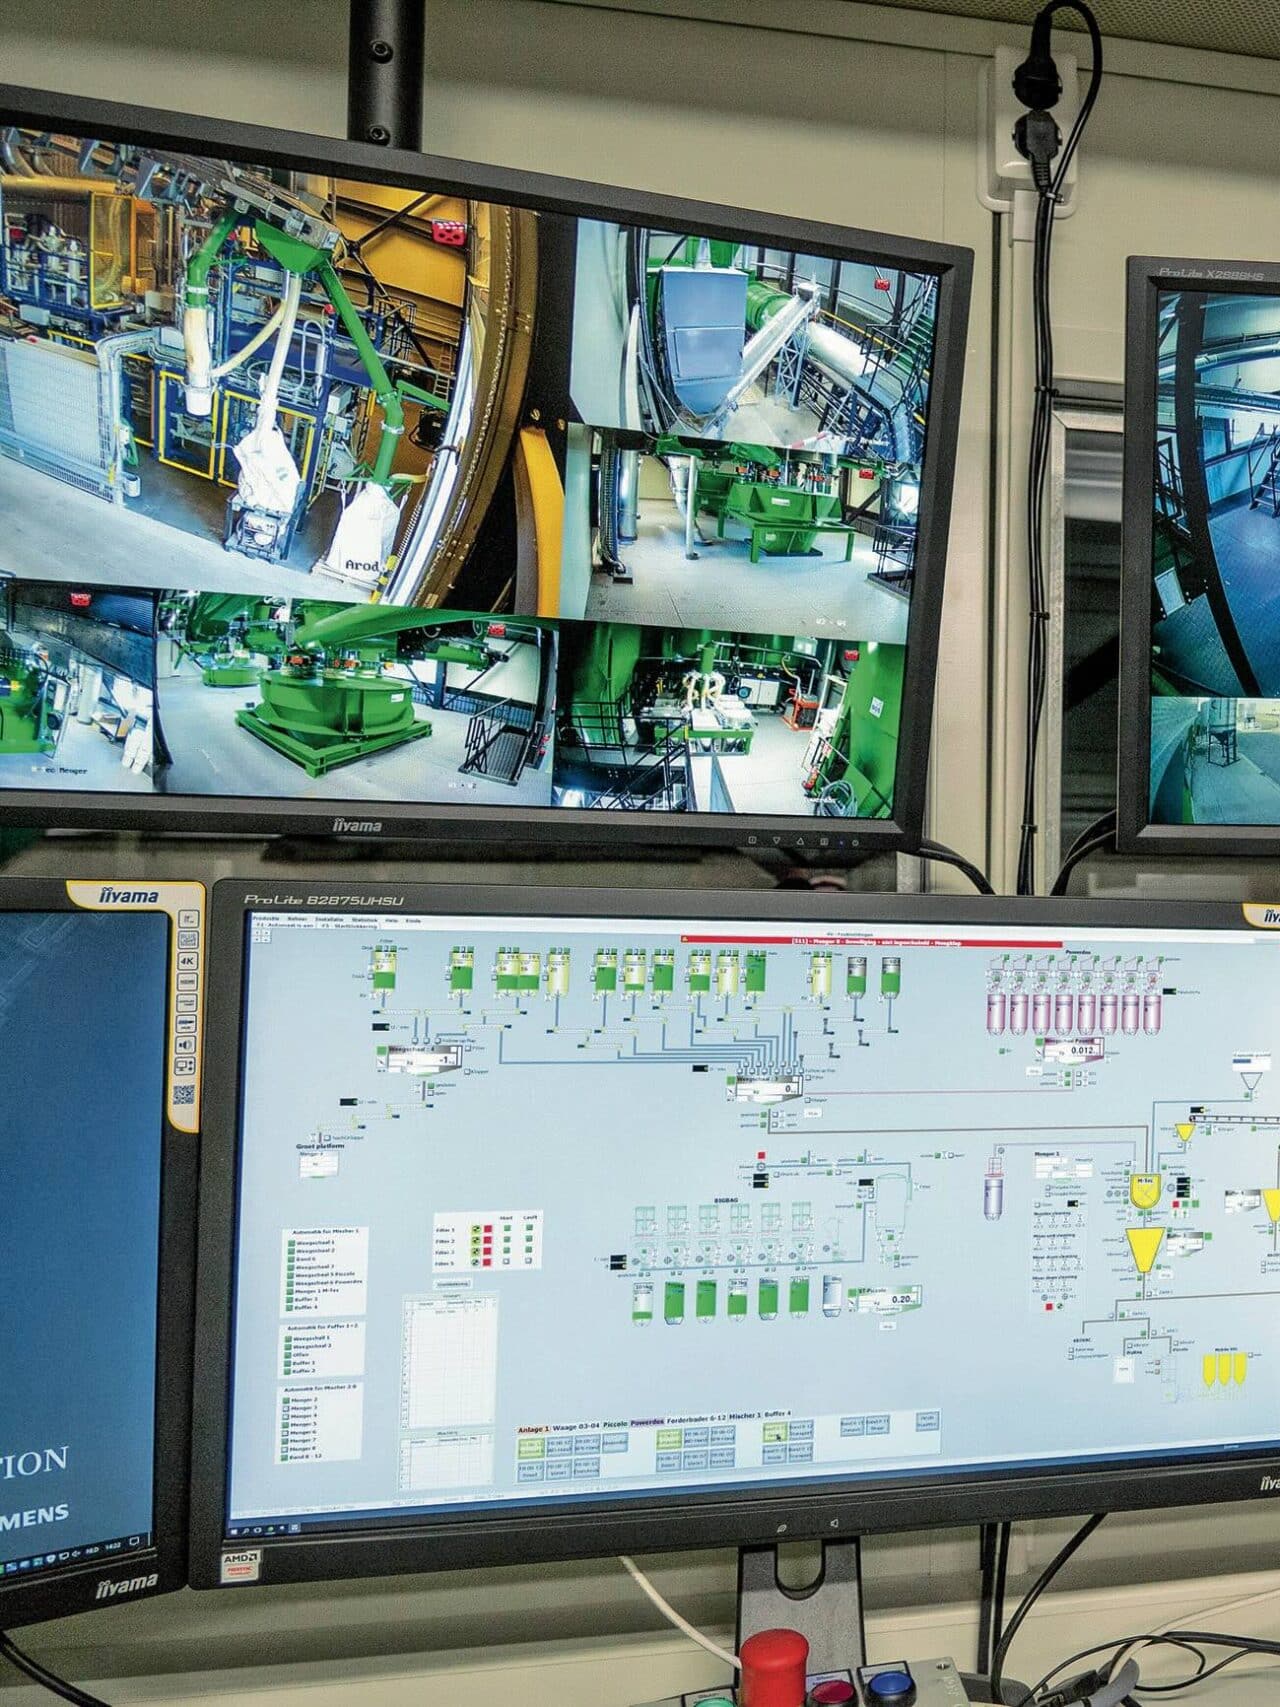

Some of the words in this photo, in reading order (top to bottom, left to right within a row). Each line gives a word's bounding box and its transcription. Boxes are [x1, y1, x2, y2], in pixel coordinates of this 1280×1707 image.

[345, 559, 379, 573] Arod
[332, 816, 382, 833] iiyama
[99, 886, 159, 904] iiyama
[244, 895, 303, 905] ProLite
[306, 896, 404, 907] B2875UHSU
[180, 956, 194, 965] 4K
[0, 1446, 69, 1479] ION
[224, 1554, 248, 1564] AMD
[96, 1573, 158, 1600] iiyama
